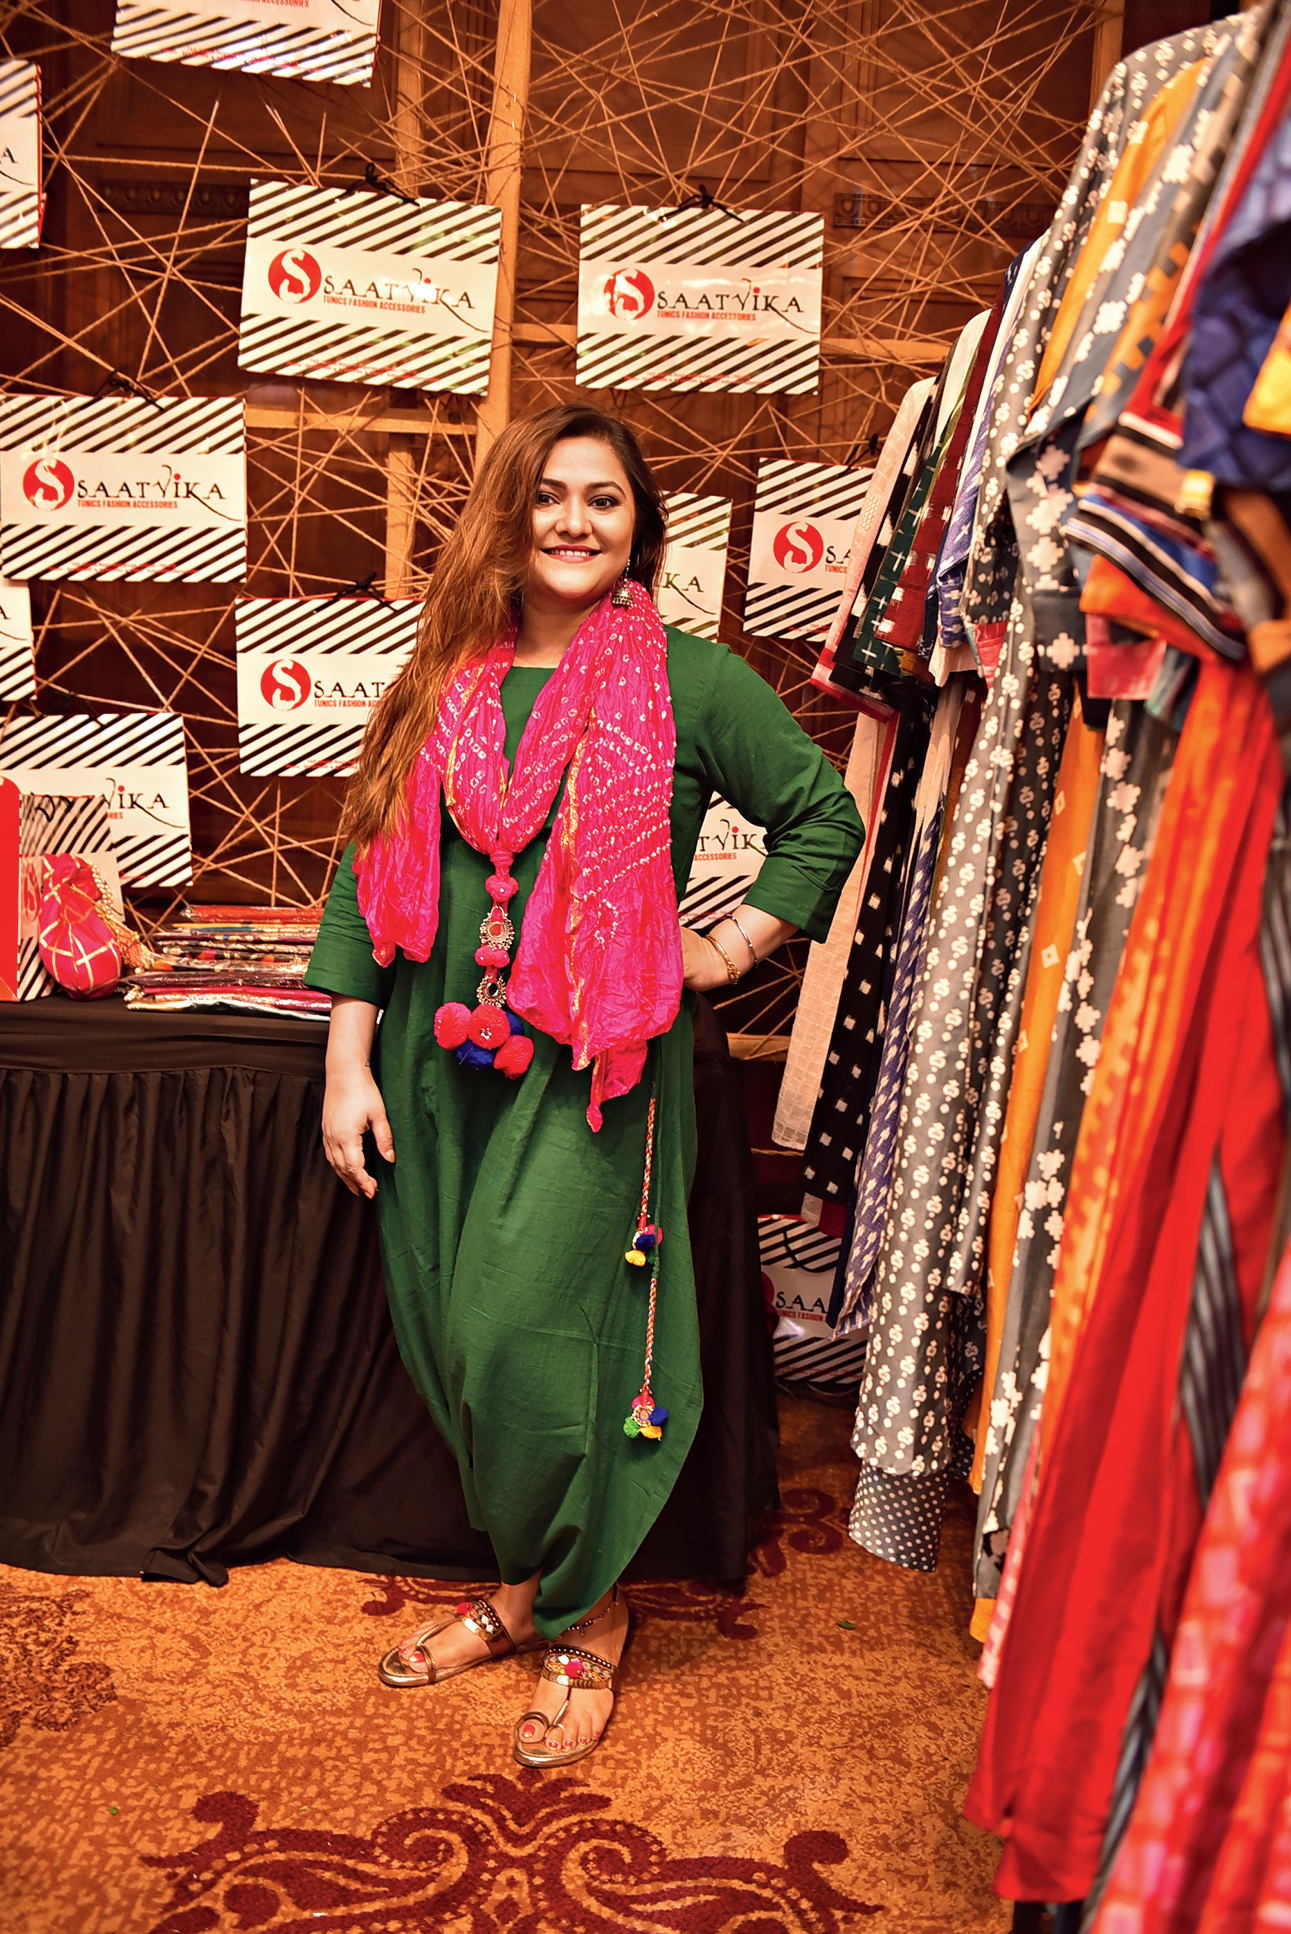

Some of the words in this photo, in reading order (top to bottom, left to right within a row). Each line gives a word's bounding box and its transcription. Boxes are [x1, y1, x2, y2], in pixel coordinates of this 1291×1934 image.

[323, 295, 347, 306] TUNICS
[348, 297, 378, 309] FASHION
[379, 301, 426, 314] ACCESSORIES
[657, 310, 680, 319] TUNICS
[681, 311, 710, 319] FASHION
[711, 312, 756, 321] ACCESSORIES
[77, 499, 101, 508] TUNICS
[102, 499, 131, 508] FASHION
[132, 500, 178, 509] ACCESSORIES
[314, 680, 385, 698] SAAT
[314, 699, 337, 708] TUNICS
[338, 699, 366, 708] FASHION
[101, 777, 186, 828] VIKA
[699, 819, 767, 857] TVIK
[694, 852, 737, 861] ACCESSORIES
